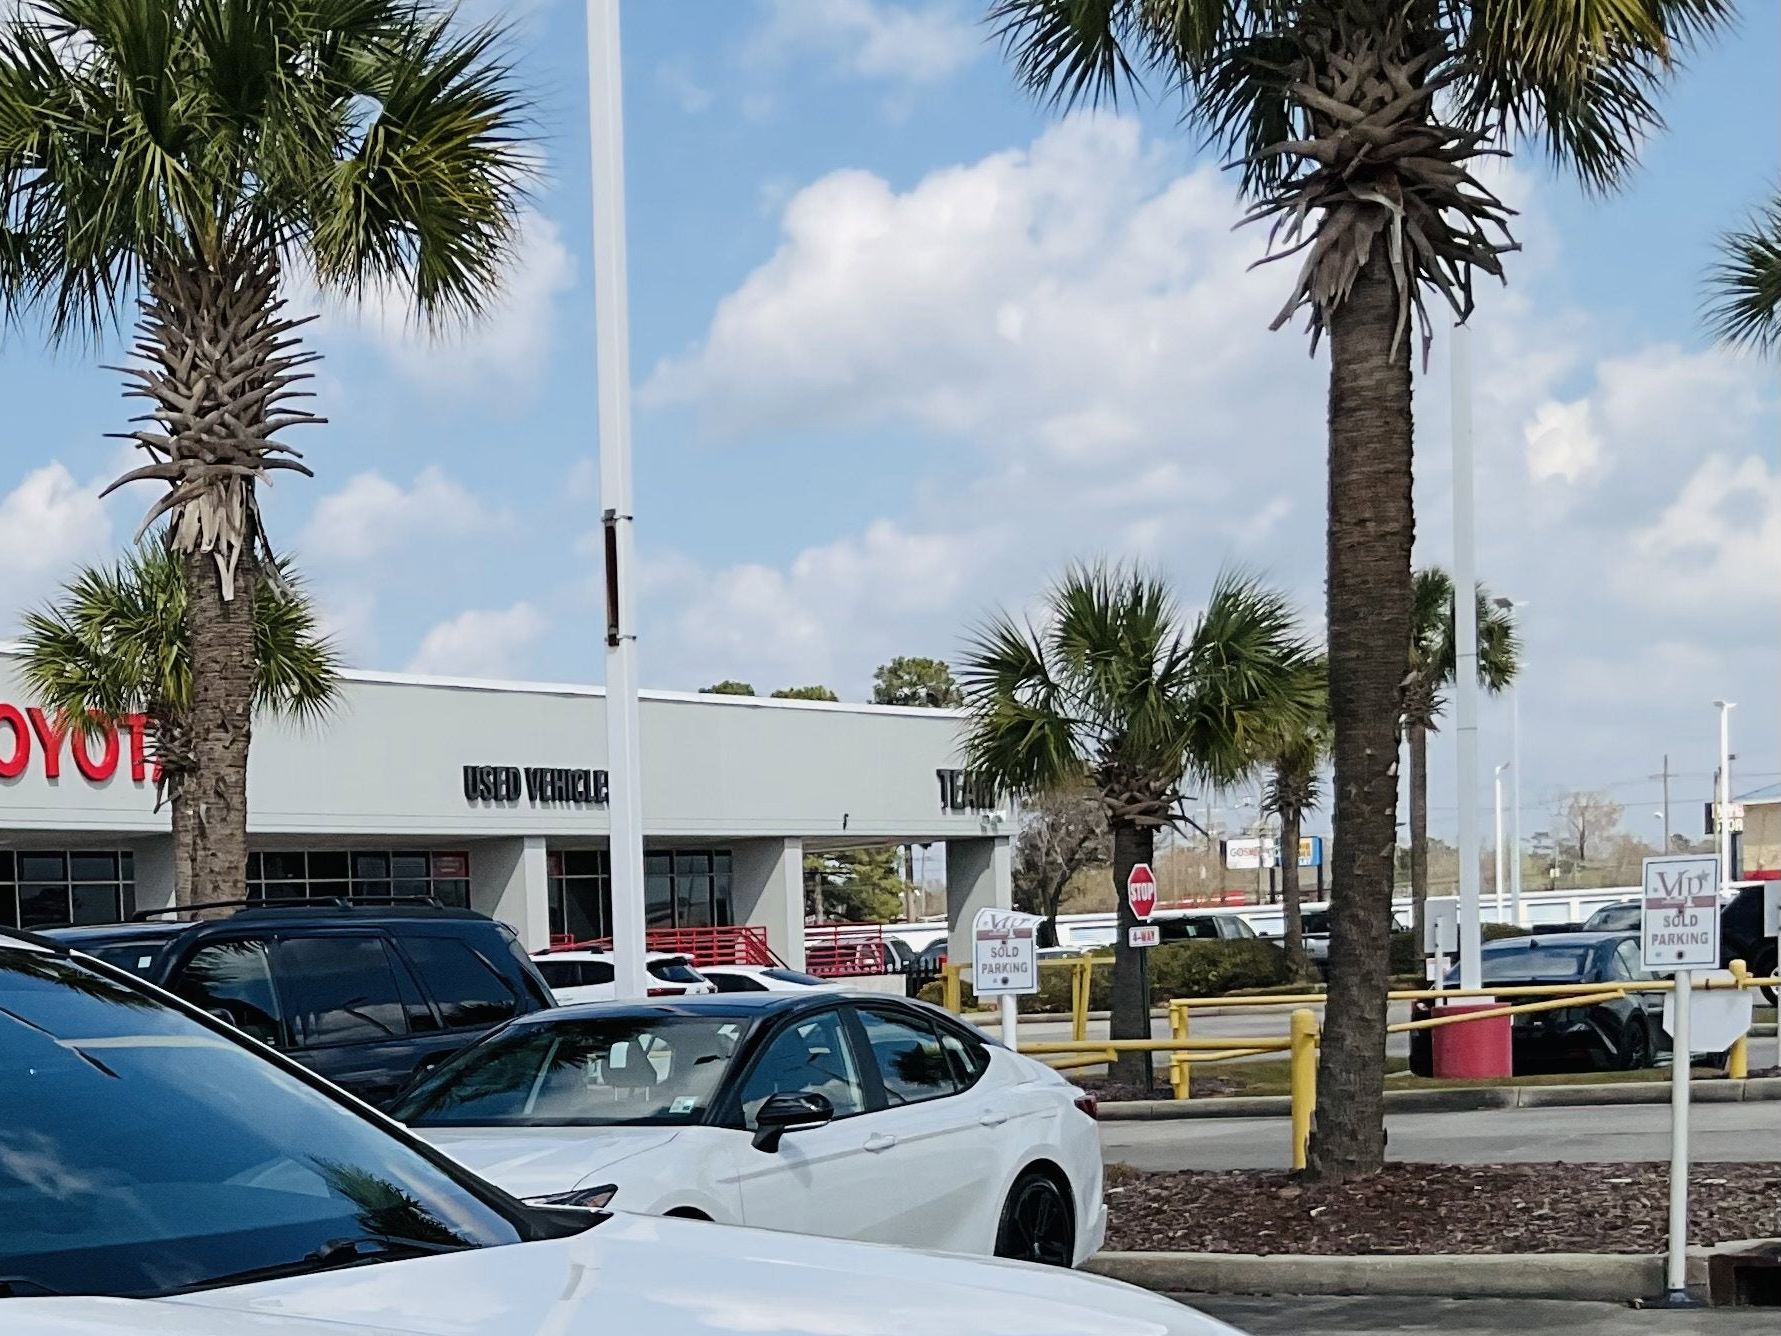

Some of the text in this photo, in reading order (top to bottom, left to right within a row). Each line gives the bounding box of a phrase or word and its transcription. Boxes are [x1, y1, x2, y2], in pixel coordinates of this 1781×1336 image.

[463, 765, 609, 806] USED VEHICLE
[1130, 882, 1154, 901] STOP
[1663, 914, 1698, 928] SOLD
[1132, 930, 1155, 942] 4-WAY
[1651, 931, 1709, 946] PARKING
[990, 946, 1019, 958] SOLD
[981, 961, 1028, 975] PARKING
